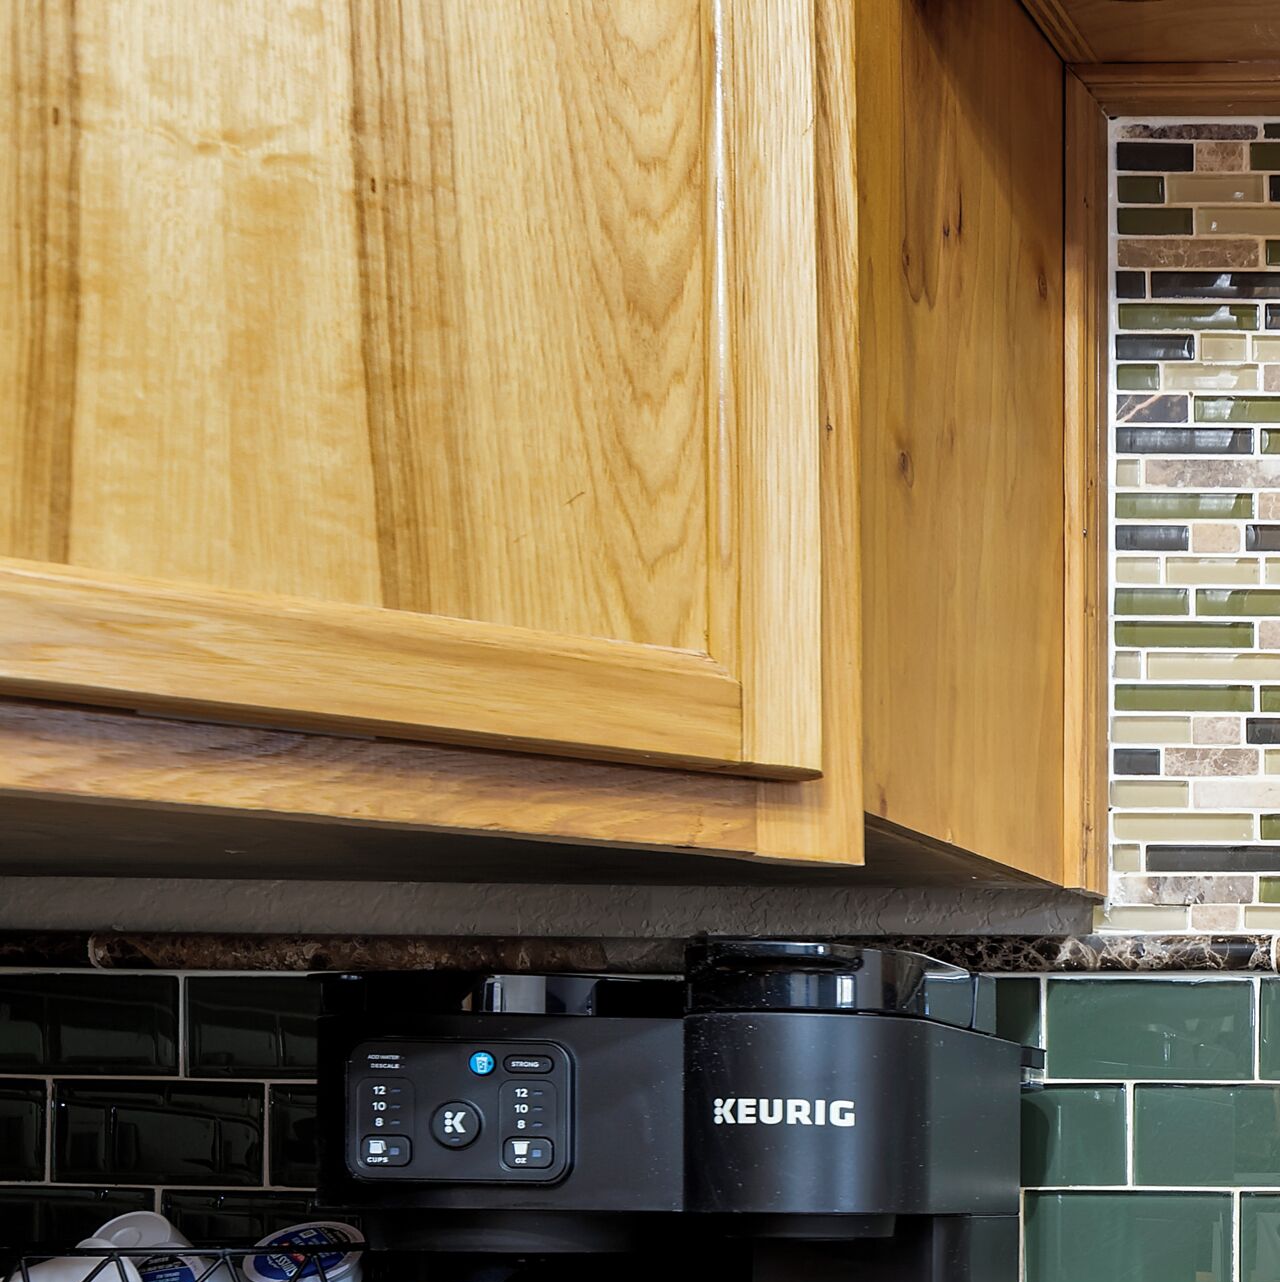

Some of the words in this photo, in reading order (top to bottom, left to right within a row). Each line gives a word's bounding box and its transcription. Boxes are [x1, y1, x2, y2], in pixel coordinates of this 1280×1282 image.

[372, 1086, 386, 1095] 12
[515, 1088, 528, 1098] 12
[372, 1102, 386, 1111] 10
[514, 1104, 528, 1114] 10
[713, 1098, 856, 1127] KEURIG
[375, 1118, 384, 1127] 8
[517, 1120, 526, 1129] 8
